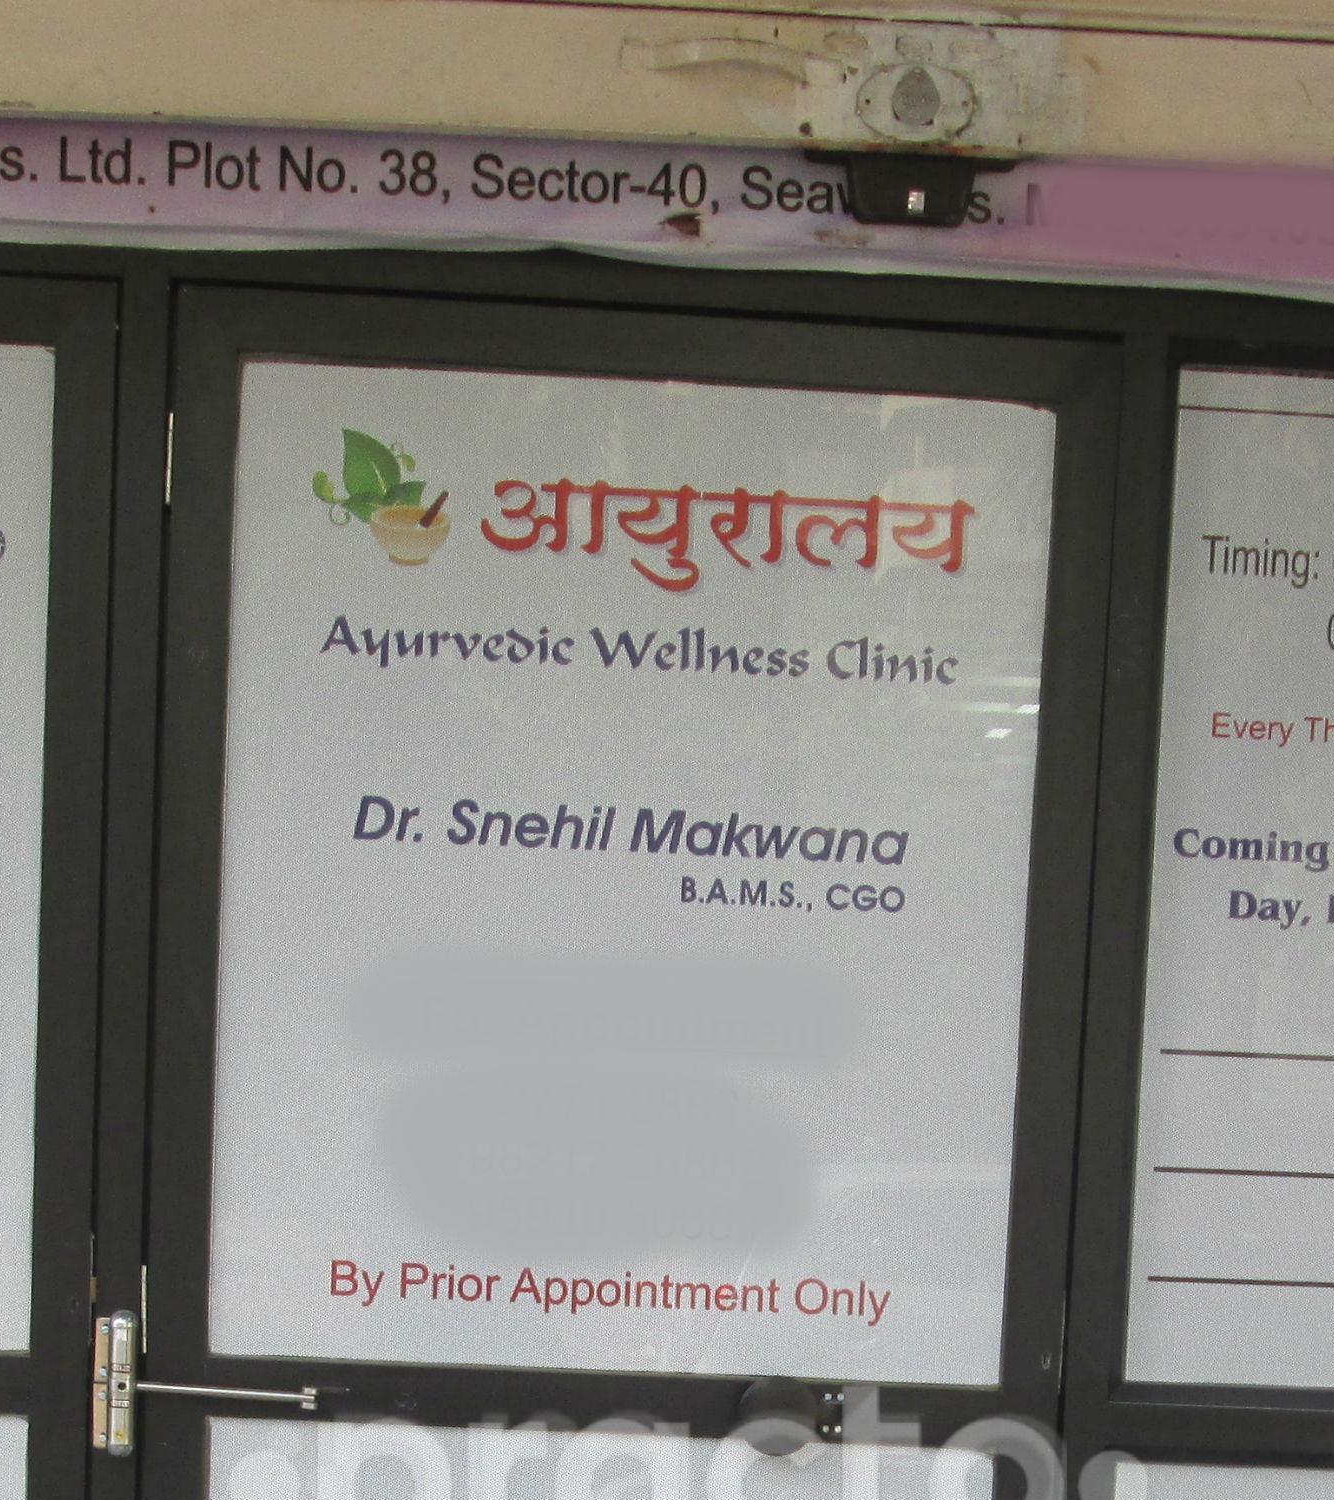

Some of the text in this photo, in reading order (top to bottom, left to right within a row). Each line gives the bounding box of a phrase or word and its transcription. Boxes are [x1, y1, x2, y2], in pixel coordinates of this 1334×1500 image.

[58, 135, 147, 186] Ltd.
[166, 139, 262, 192] Plot
[277, 146, 359, 195] No.
[378, 150, 451, 203] 38,
[470, 154, 720, 213] Sector-40,
[481, 477, 980, 592] आयुरालय
[1201, 534, 1321, 589] Timing:
[320, 615, 959, 686] Ayurvedic Wellness Clinic
[1210, 712, 1295, 749] Every
[352, 795, 910, 866] Dr. Snehil Makwana
[1172, 827, 1330, 873] Coming
[680, 876, 906, 914] B.A.M.S., CGO
[1227, 889, 1311, 930] Day,
[328, 1260, 892, 1328] By Prior Appointment Only
